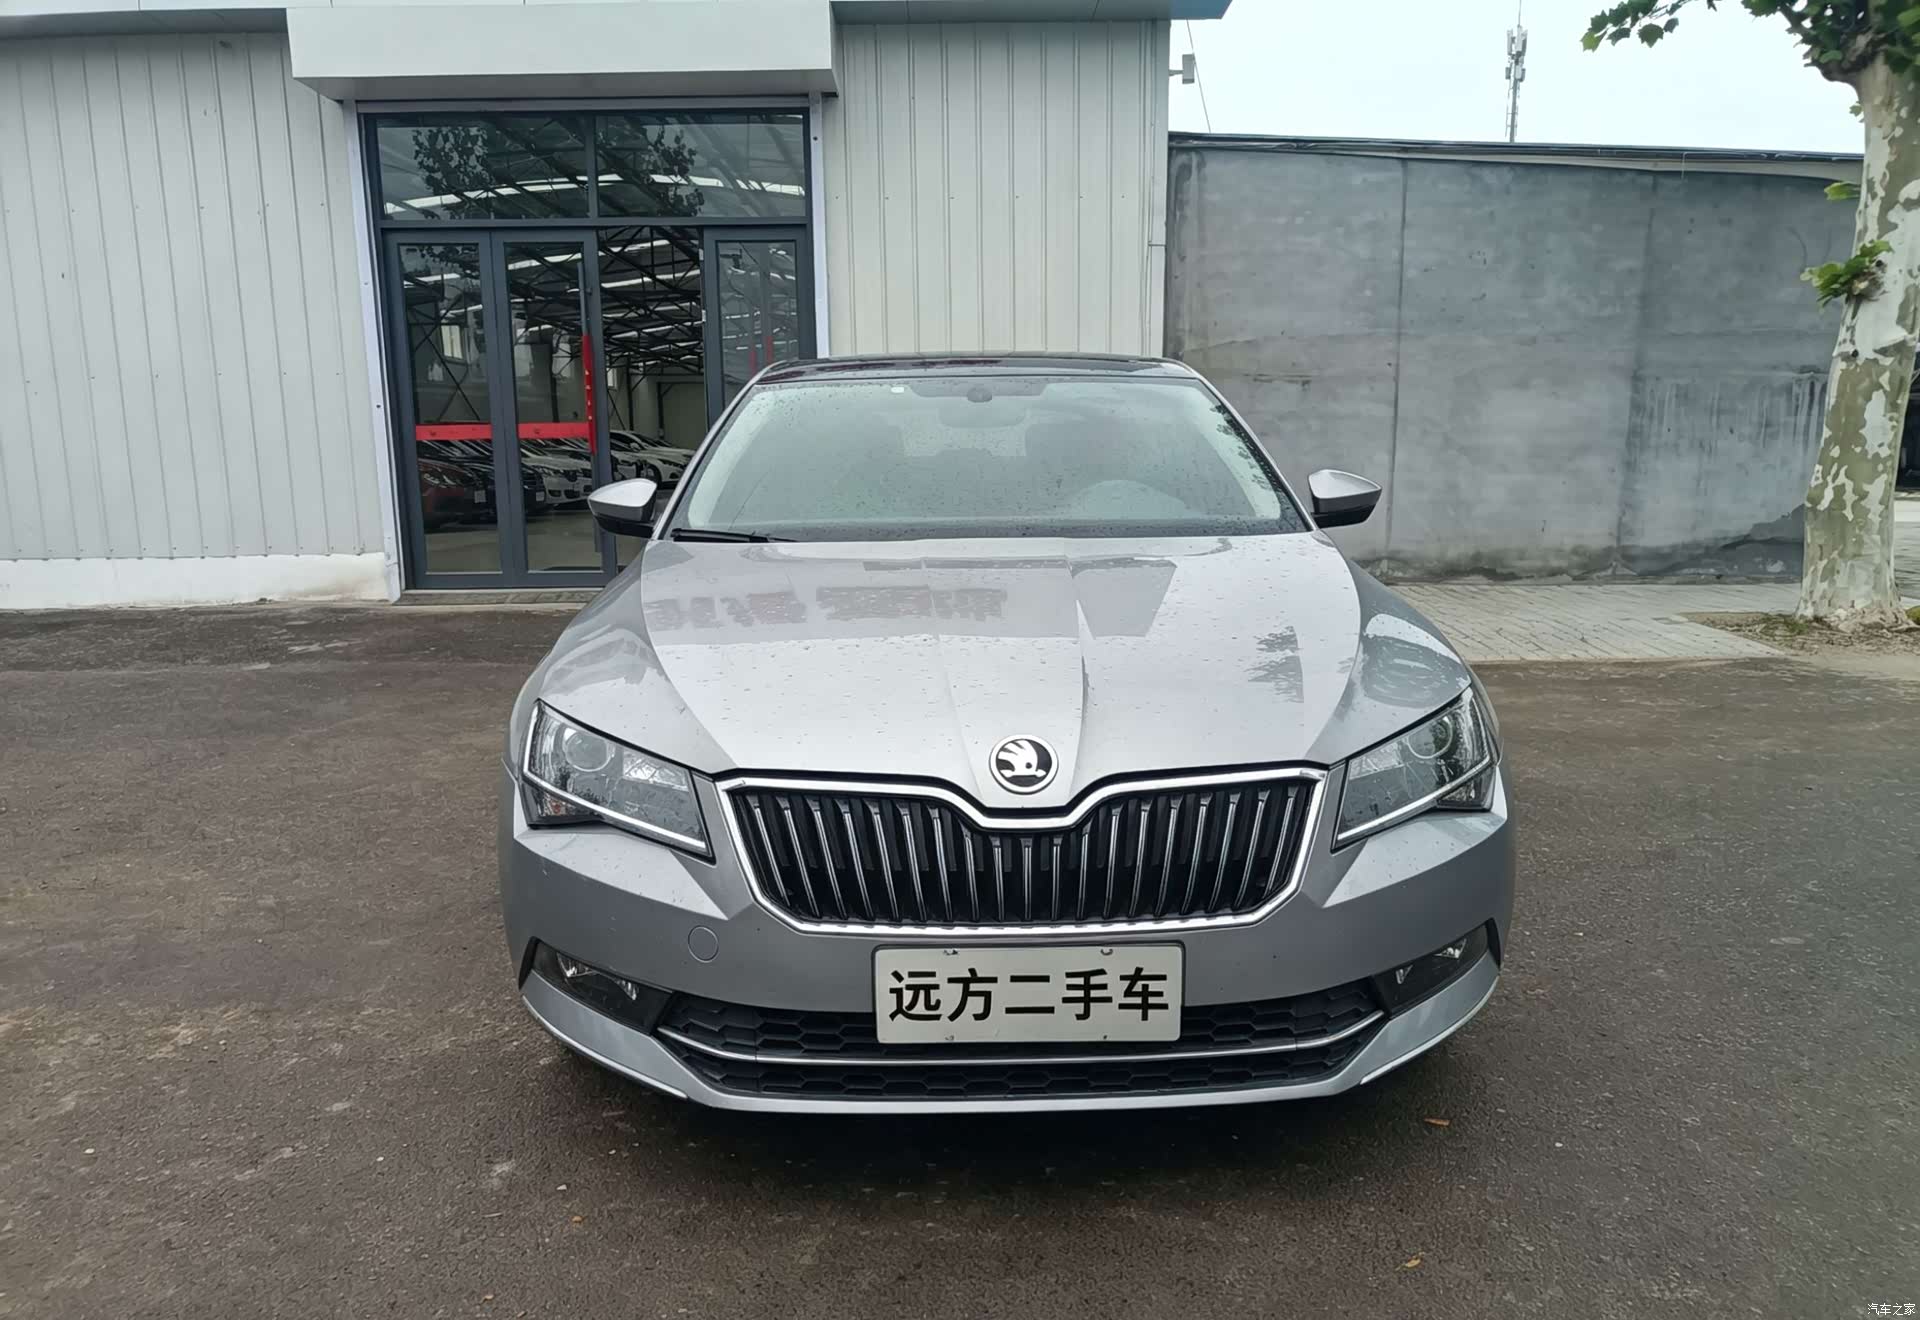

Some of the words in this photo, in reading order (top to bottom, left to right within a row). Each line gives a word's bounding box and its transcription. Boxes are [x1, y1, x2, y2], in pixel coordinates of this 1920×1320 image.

[888, 966, 1169, 1022] 远方二手车
